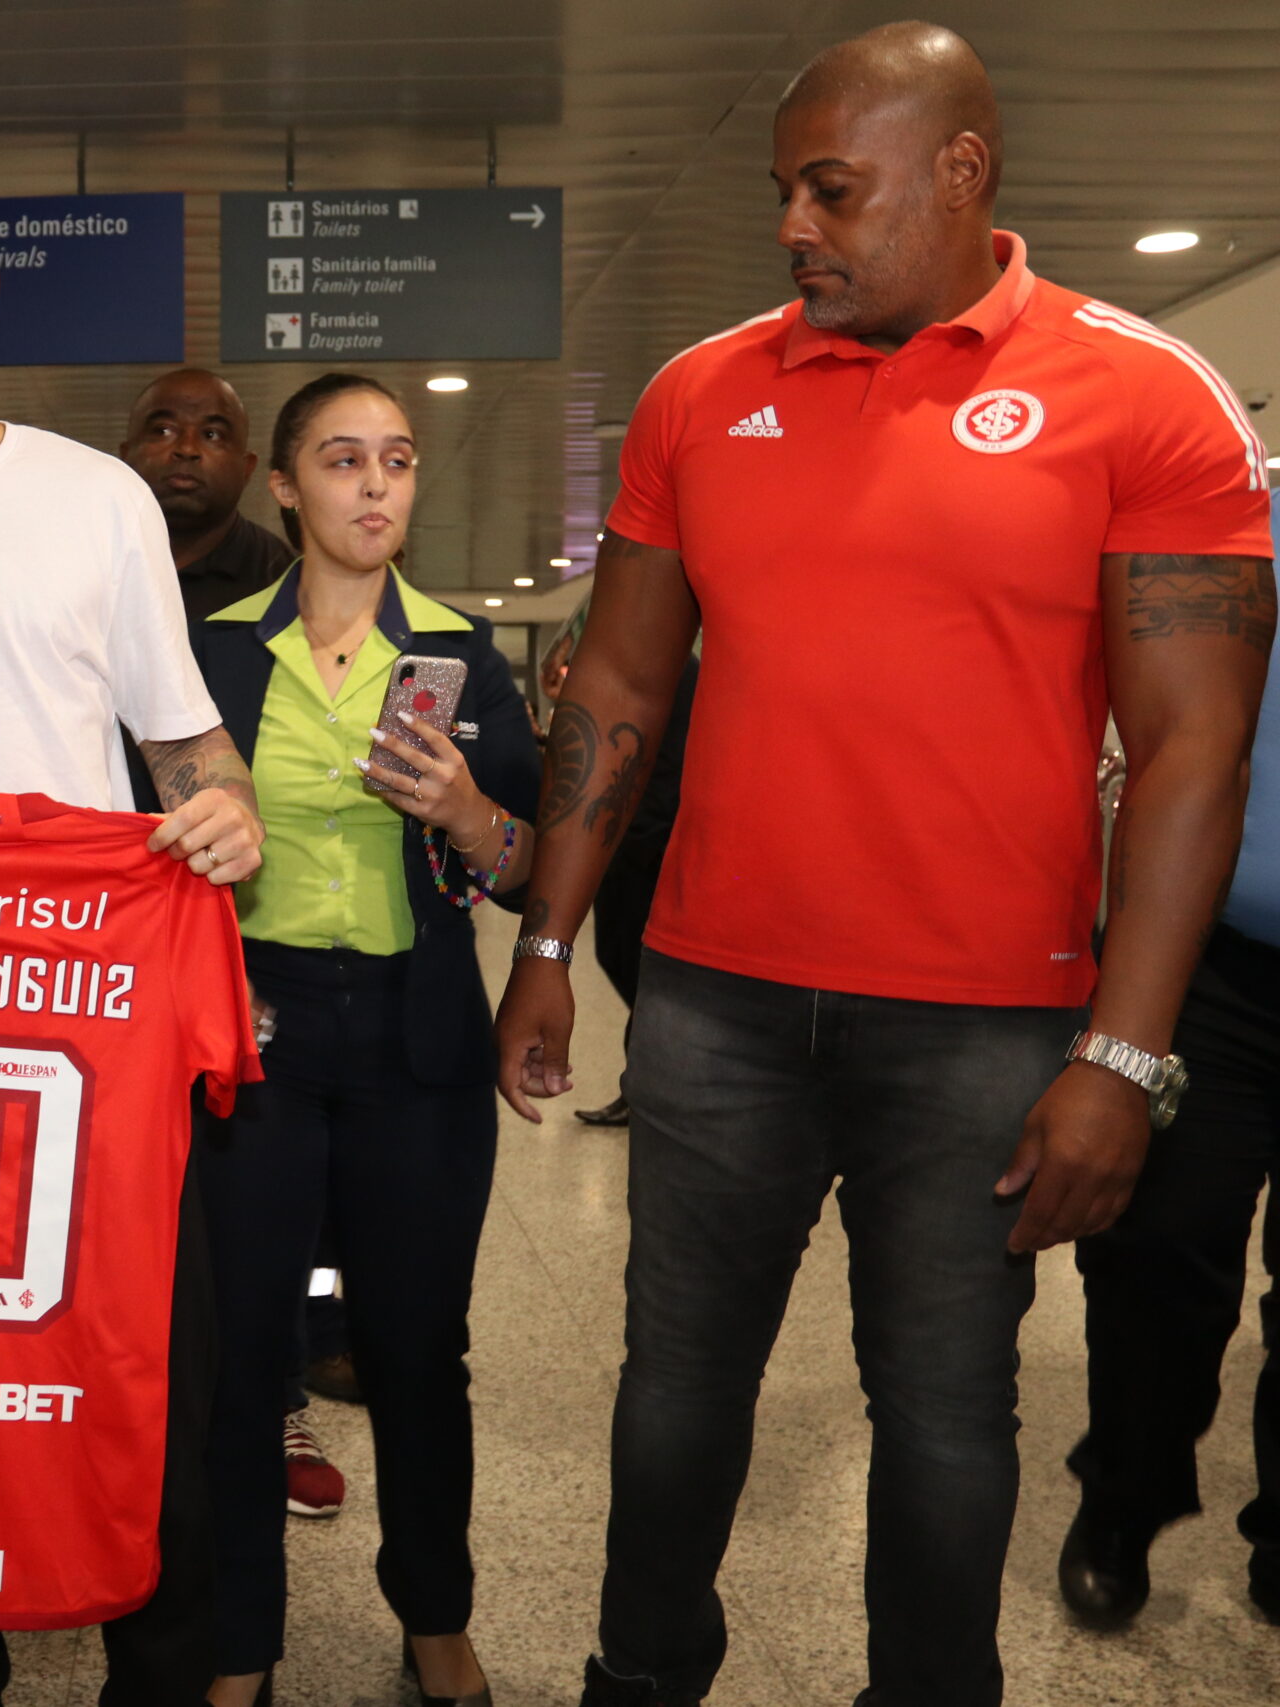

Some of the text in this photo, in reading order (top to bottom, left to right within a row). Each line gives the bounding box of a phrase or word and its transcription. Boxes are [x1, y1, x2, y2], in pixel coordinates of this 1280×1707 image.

[311, 200, 389, 216] Sanitários
[15, 213, 129, 237] doméstico
[311, 221, 361, 237] Toilets
[311, 256, 437, 273] Sanitário família
[311, 278, 405, 296] Family toilet
[309, 312, 379, 328] Farmácia
[308, 333, 383, 352] Drugstore
